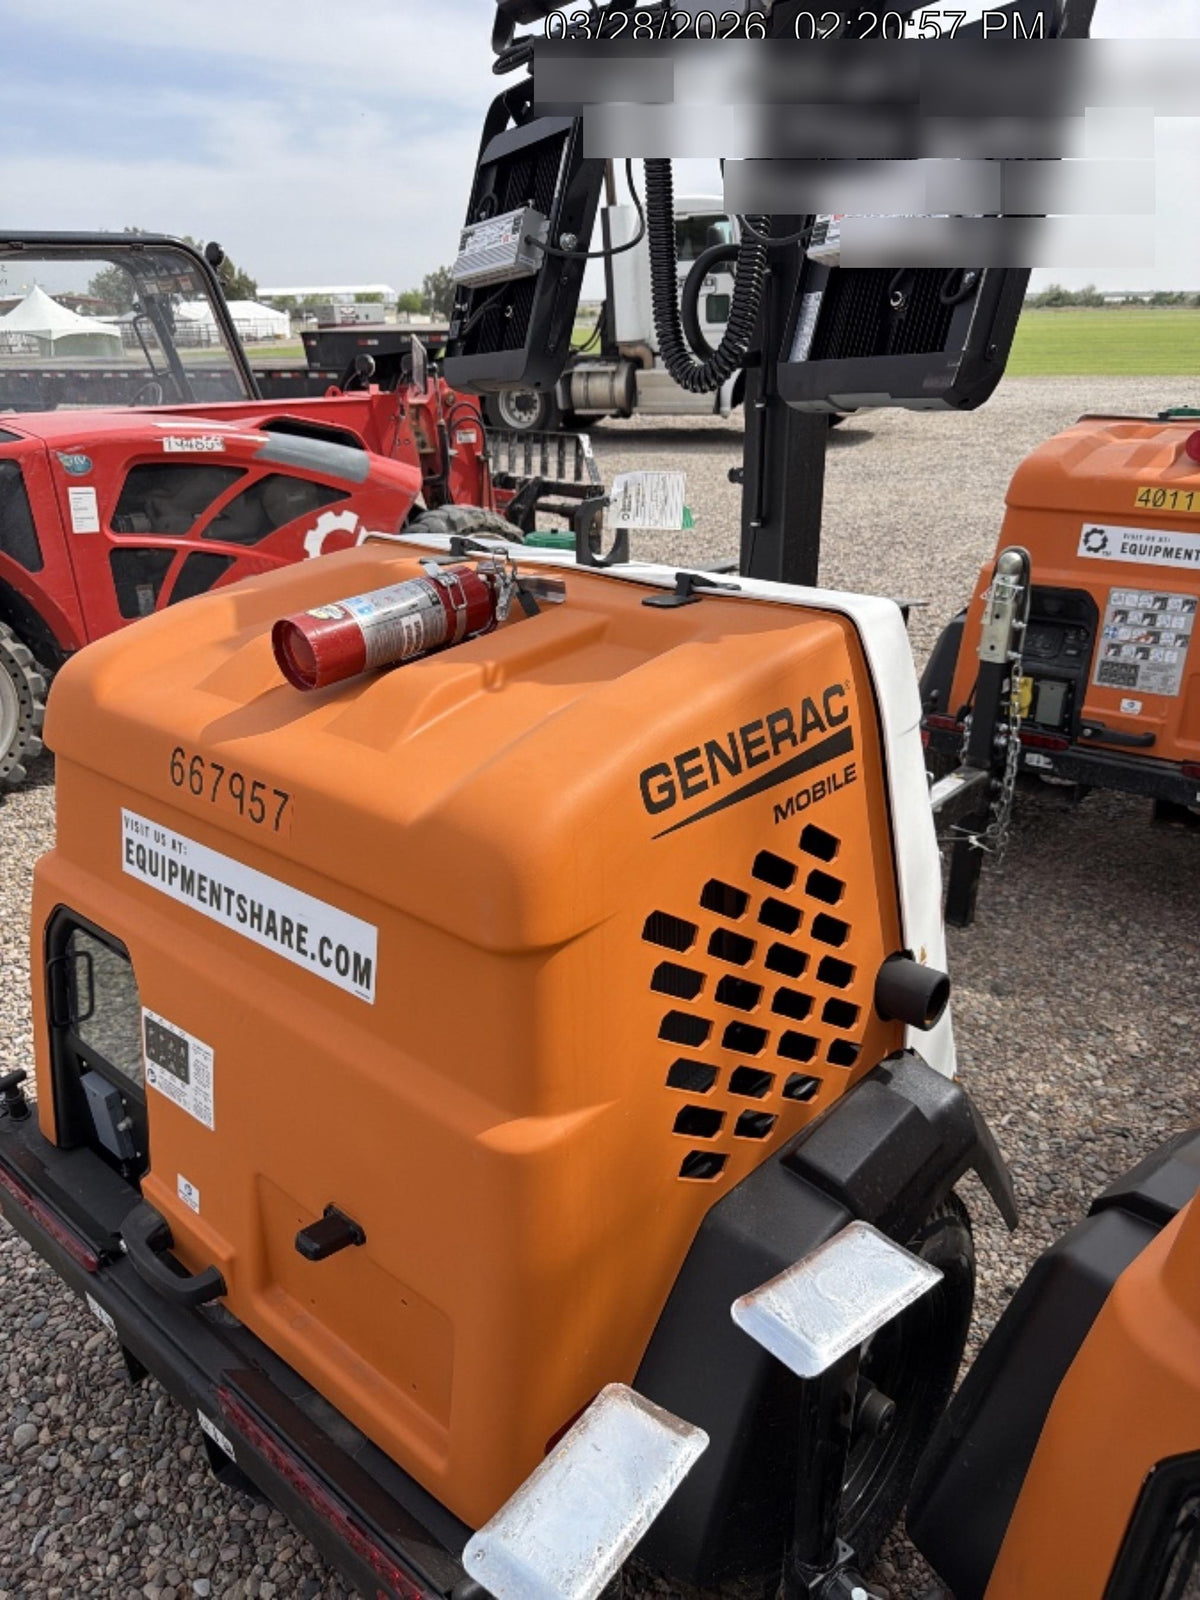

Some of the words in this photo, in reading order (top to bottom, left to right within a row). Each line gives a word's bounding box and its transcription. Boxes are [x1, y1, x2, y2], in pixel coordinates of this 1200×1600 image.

[169, 746, 289, 832] 667957
[639, 684, 850, 815] GENERAC
[123, 815, 150, 838] VISIT
[154, 829, 167, 847] US
[772, 763, 858, 825] MOBILE
[125, 837, 373, 991] EQUIPMENTSHARE.COM
